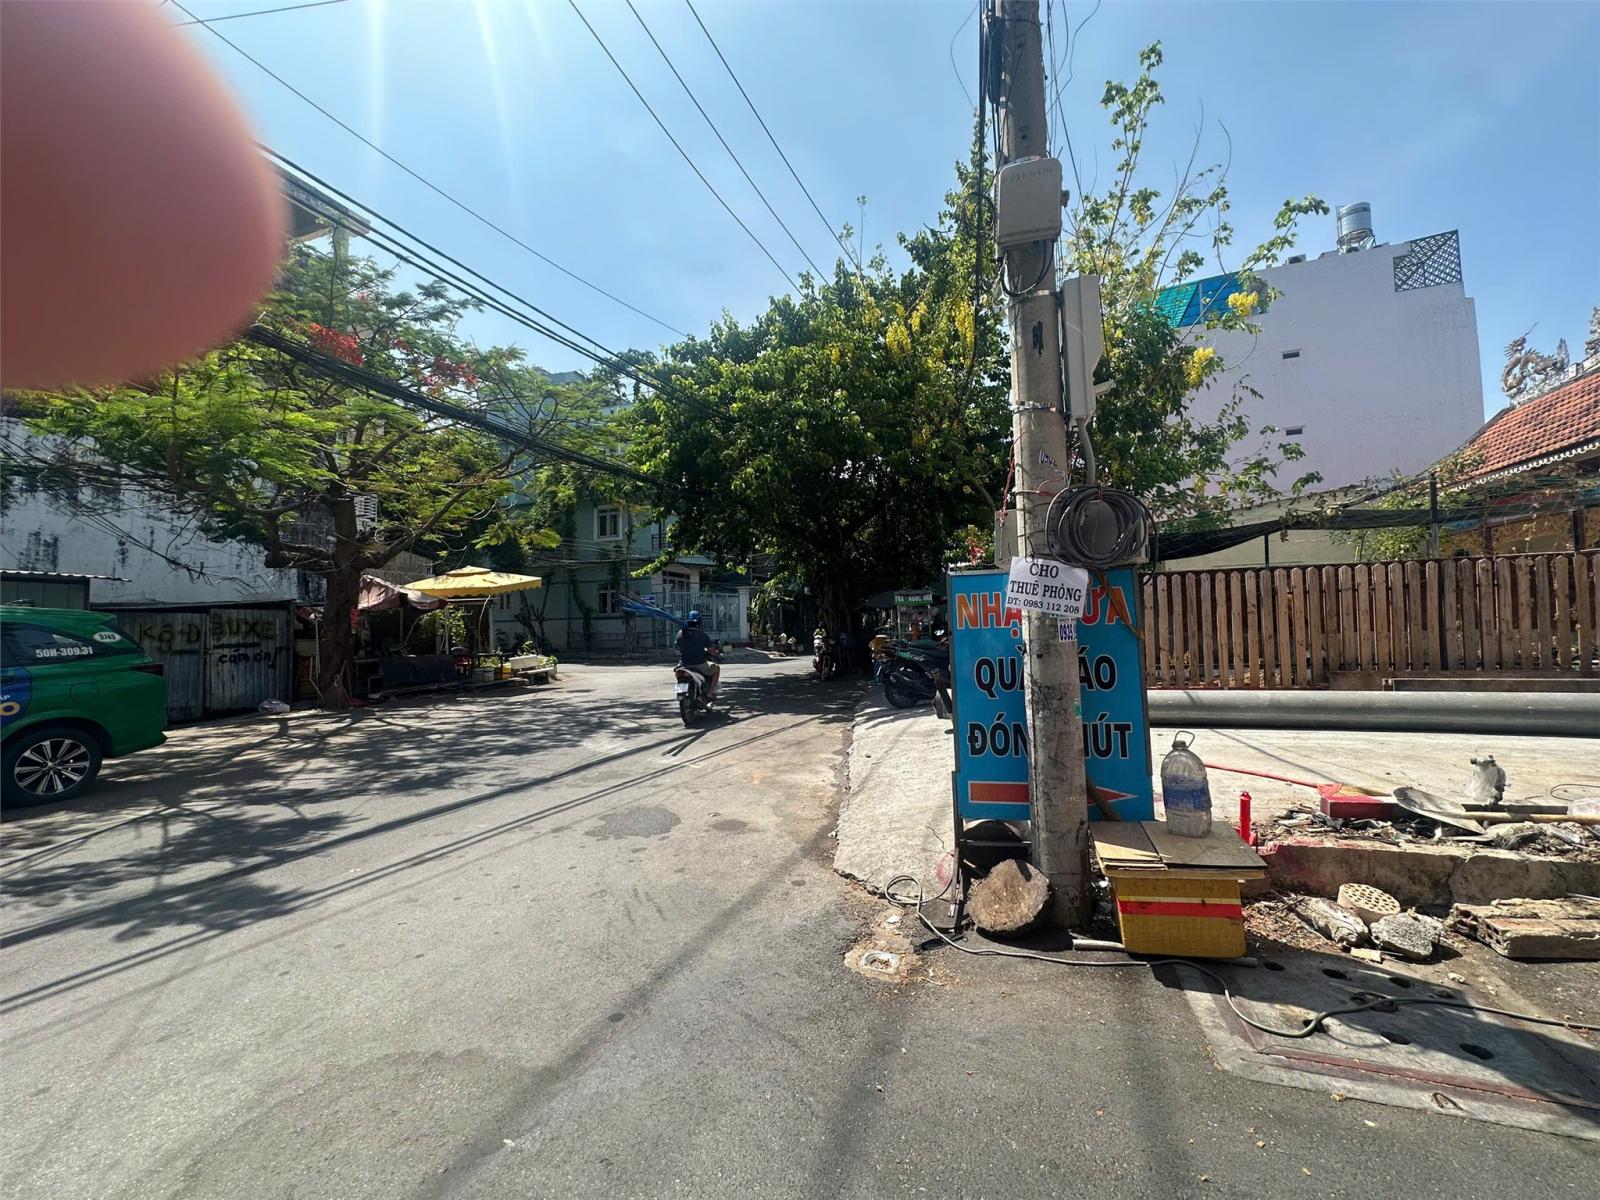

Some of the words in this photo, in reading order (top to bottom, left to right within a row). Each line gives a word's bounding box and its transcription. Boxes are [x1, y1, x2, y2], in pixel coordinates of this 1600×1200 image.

[1029, 563, 1059, 579] CHO
[1009, 579, 1040, 597] THUÊ
[1042, 583, 1082, 602] PHÒNG
[1023, 598, 1044, 609] 0983
[1046, 601, 1061, 612] 112
[1063, 604, 1080, 614] 208
